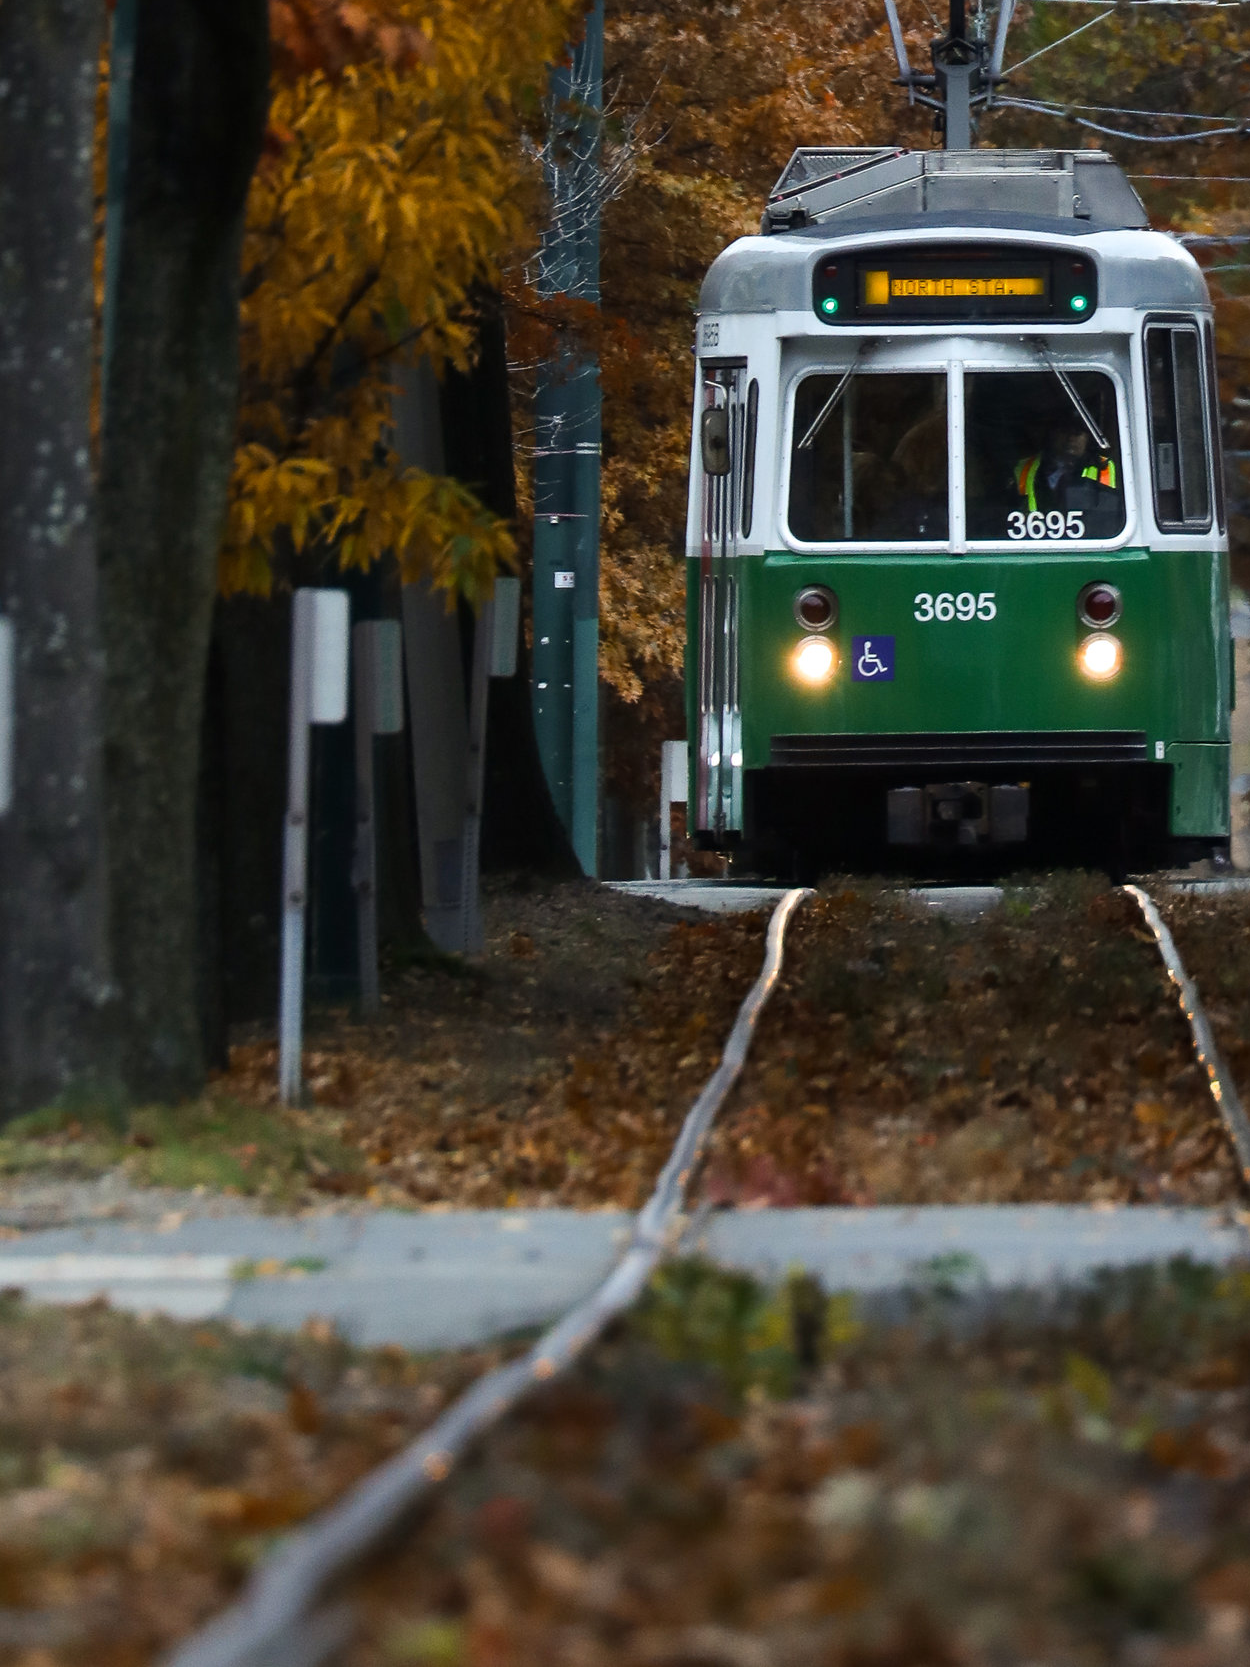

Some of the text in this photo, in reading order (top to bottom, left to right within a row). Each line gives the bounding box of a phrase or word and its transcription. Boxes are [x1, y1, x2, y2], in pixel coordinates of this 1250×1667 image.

[892, 279, 1014, 295] NORTH STA.
[1007, 510, 1085, 539] 3695
[914, 592, 997, 622] 3695
